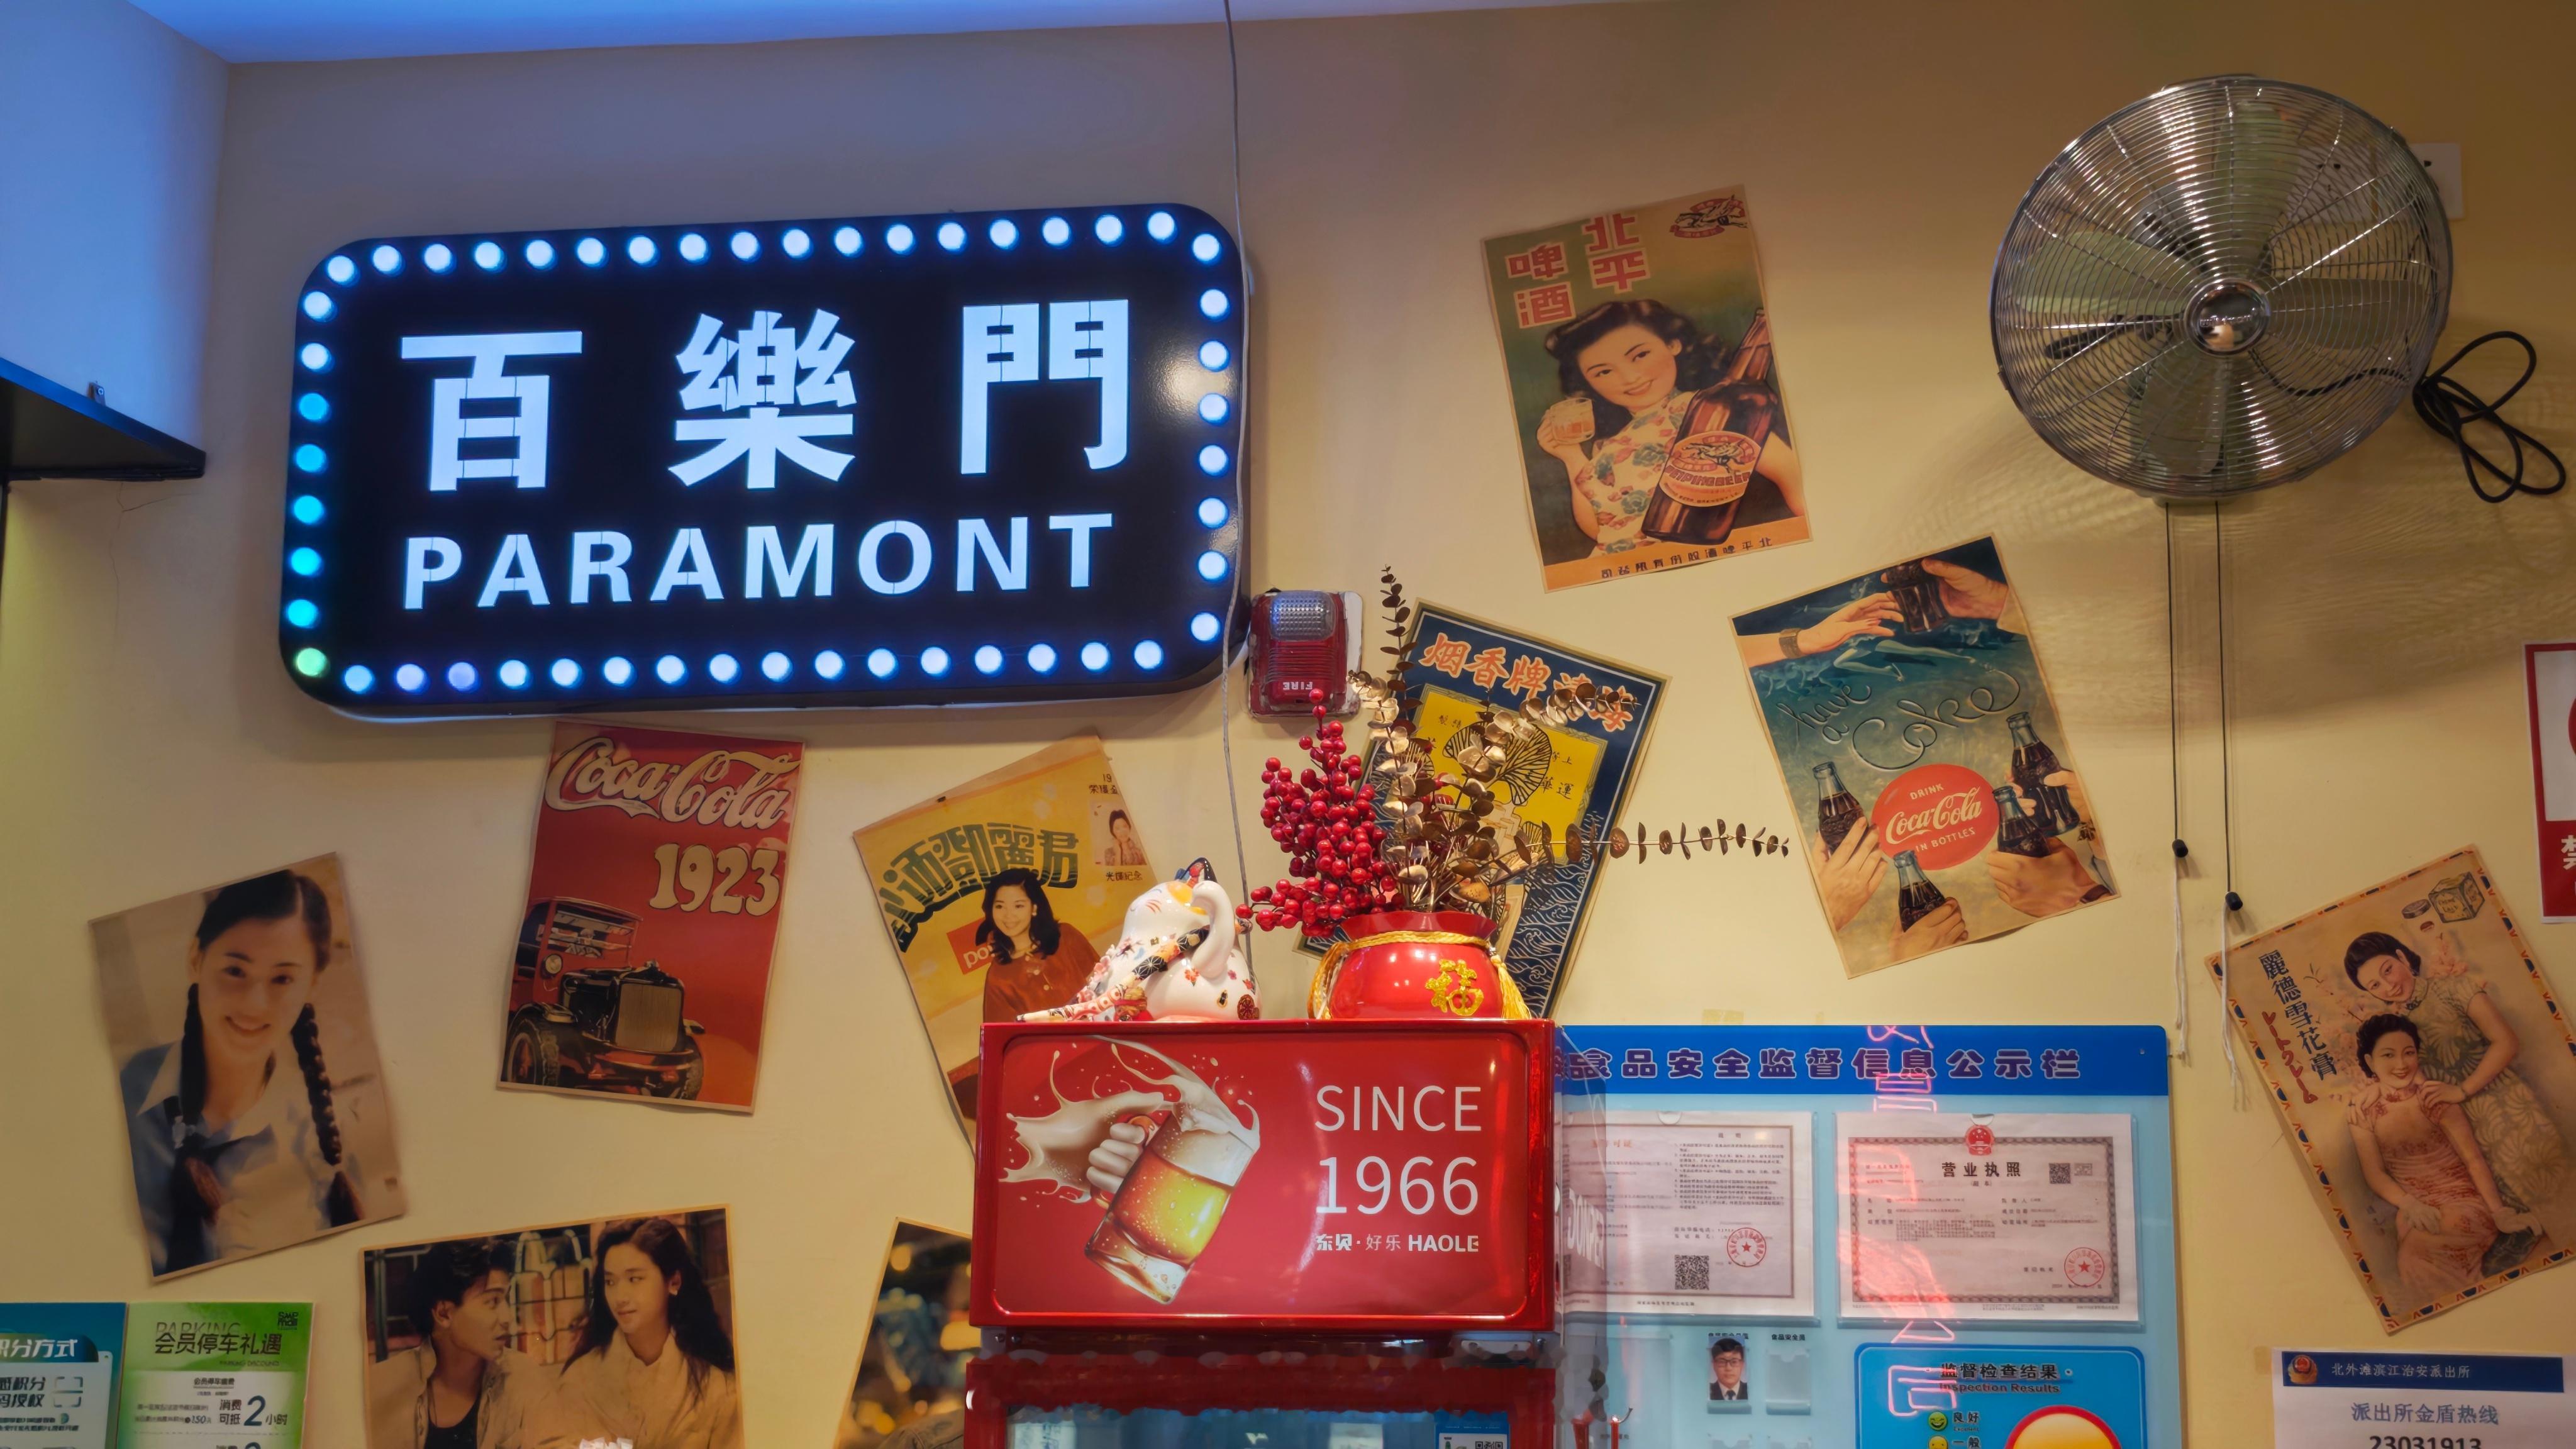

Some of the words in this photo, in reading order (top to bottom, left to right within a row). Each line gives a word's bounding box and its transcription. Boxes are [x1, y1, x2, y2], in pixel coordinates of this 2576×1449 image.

[401, 299, 1129, 491] 百樂門
[403, 513, 1113, 609] PARAMONT
[1283, 681, 1313, 690] FIRE
[1776, 684, 1872, 736] have
[1821, 724, 1850, 745] a
[1852, 663, 2021, 771] Coke
[544, 737, 802, 830] Coca-Cola
[1910, 783, 1944, 801] DRINK
[1885, 786, 1983, 845] Coca-Cola
[1915, 840, 1929, 853] IN
[1931, 826, 1975, 850] BOTTLES
[649, 843, 781, 916] 1923
[1316, 1085, 1482, 1132] SINCE
[1941, 1162, 2021, 1178] 营业执照
[1316, 1156, 1479, 1216] 1966
[1408, 1235, 1479, 1252] HAOLE
[155, 1332, 282, 1355] 会员停车礼遇
[1941, 1363, 2058, 1380] 监督检查结果
[2331, 1362, 2471, 1379] 北外滩滨江治安派出所
[1940, 1383, 2007, 1394] Inspection
[2011, 1383, 2060, 1393] Results
[219, 1399, 242, 1411] 消费
[244, 1395, 266, 1426] 2
[1953, 1412, 1979, 1423] 良好
[2351, 1402, 2499, 1425] 派出所金盾热线
